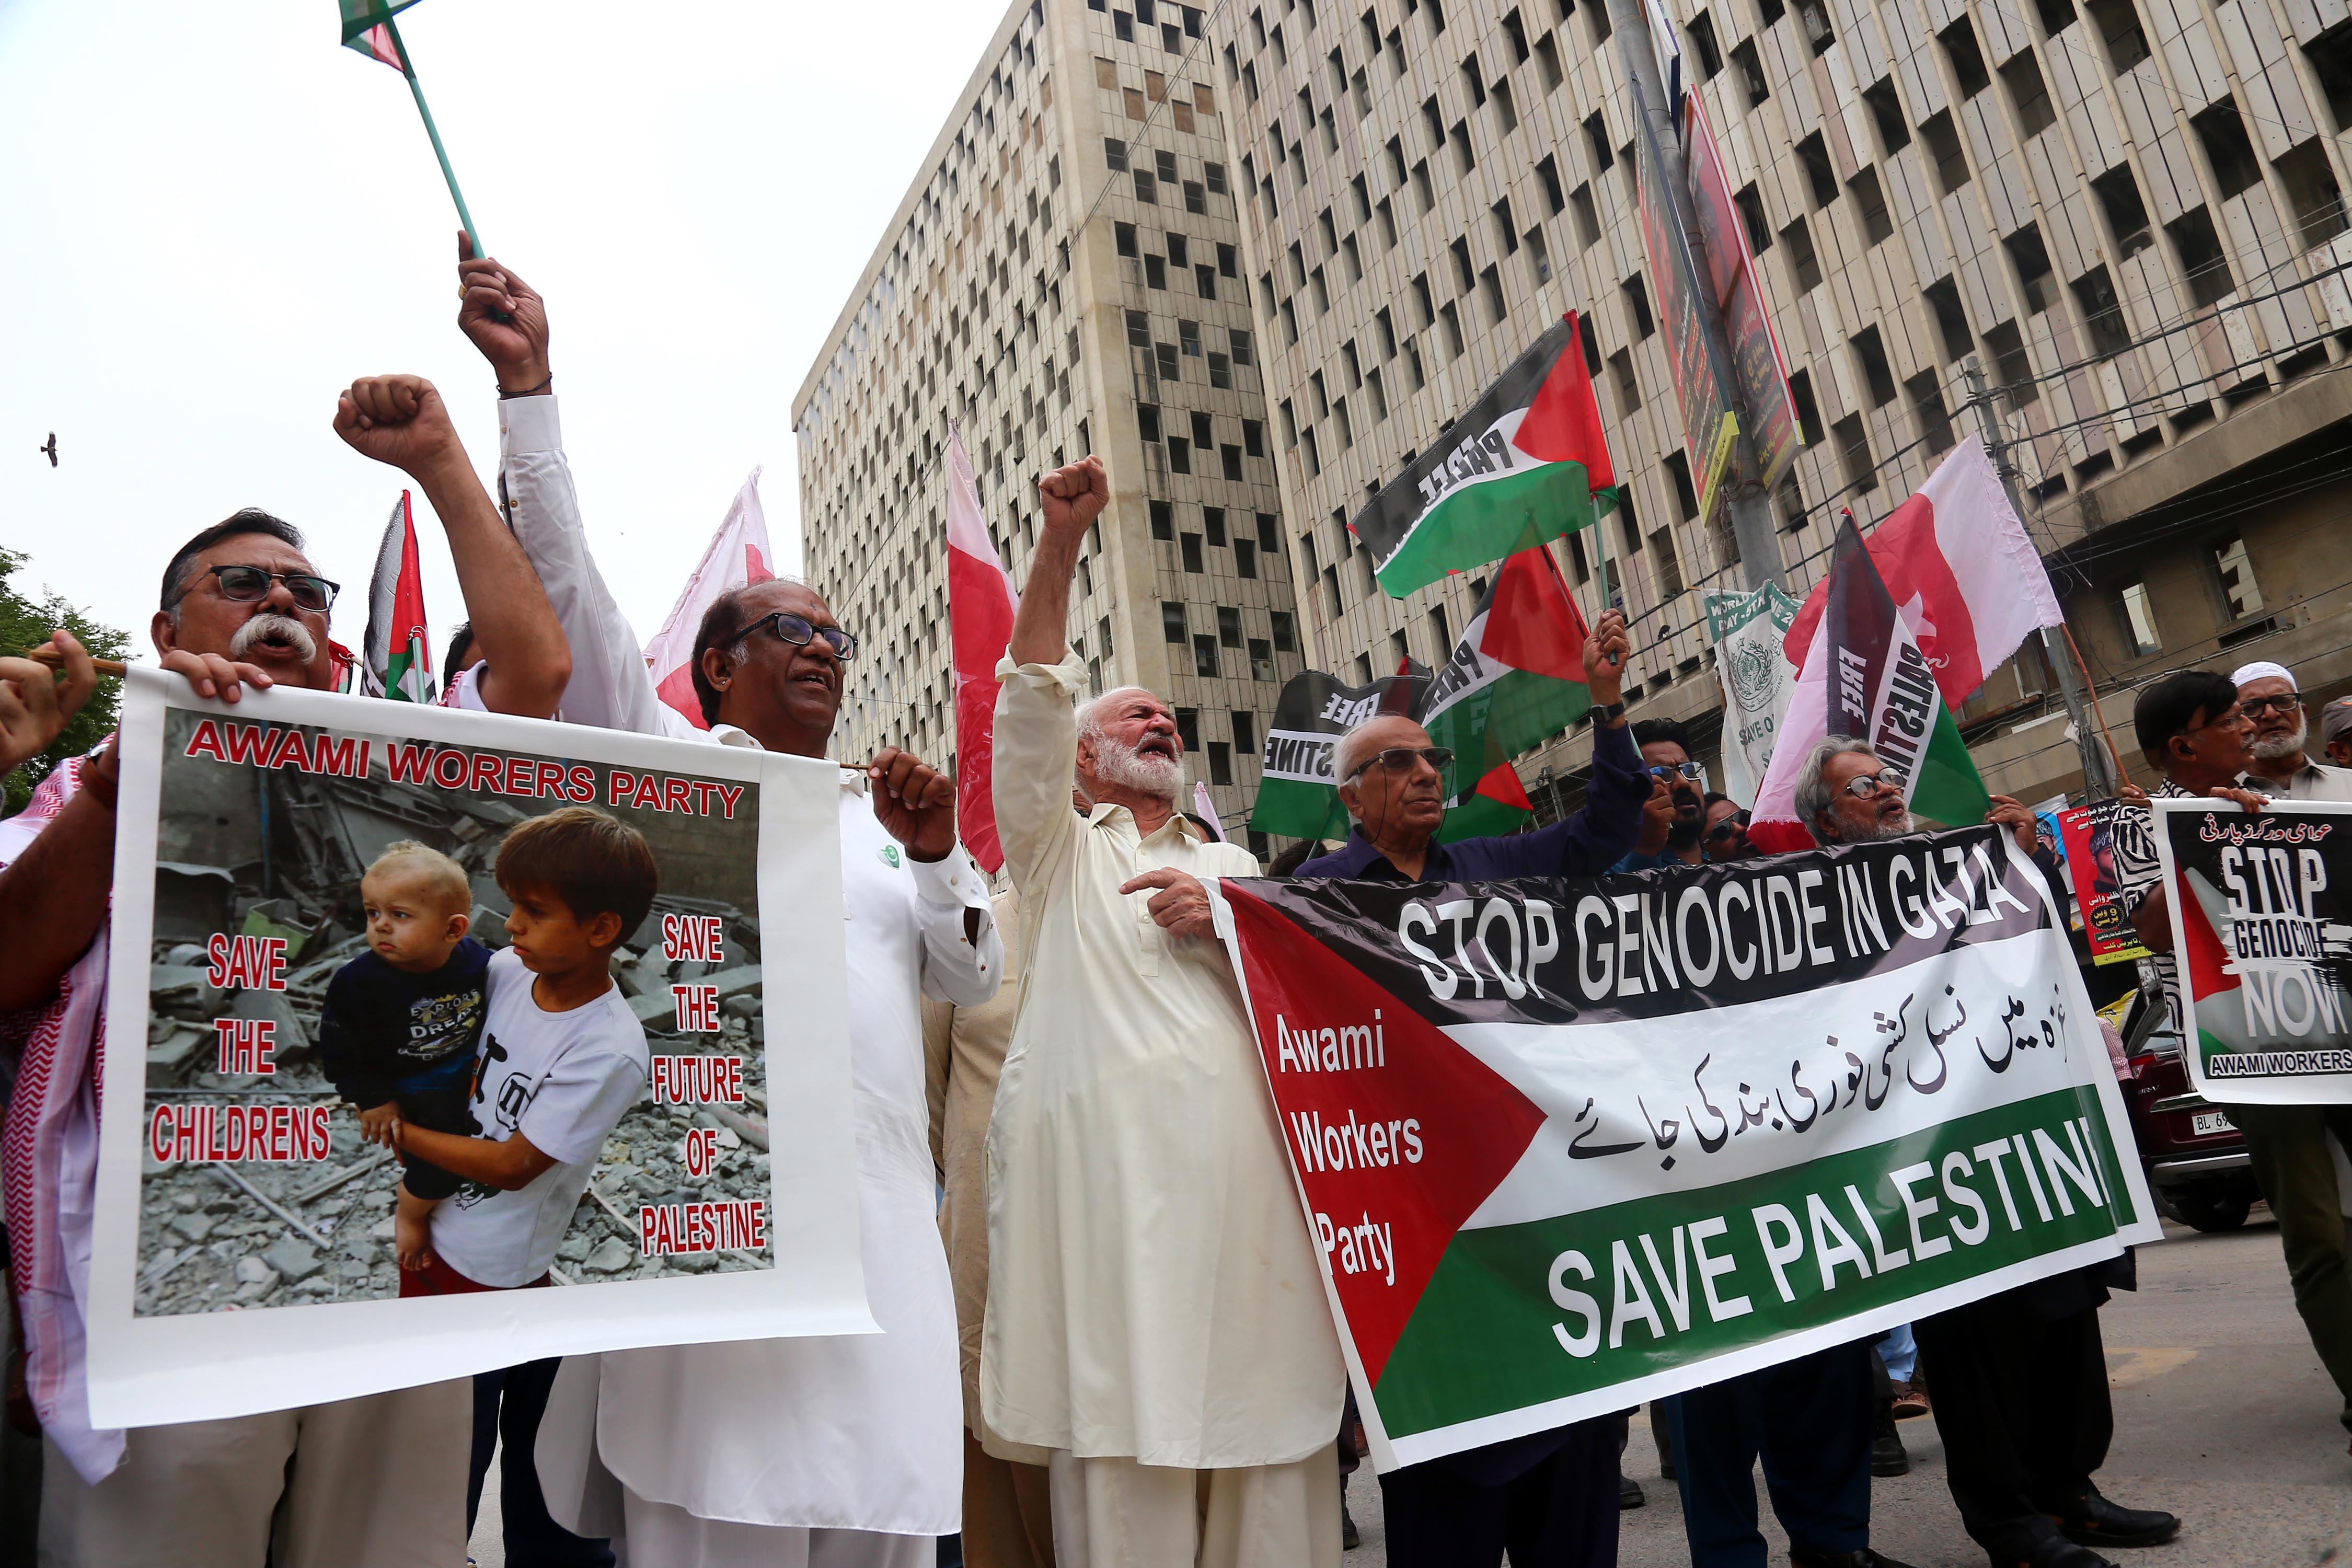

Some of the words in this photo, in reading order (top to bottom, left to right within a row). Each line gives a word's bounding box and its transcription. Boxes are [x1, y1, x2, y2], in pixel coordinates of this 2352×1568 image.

[1711, 594, 1749, 616] WORLD
[1719, 613, 1738, 631] DAY
[1739, 721, 1764, 746] SAVE
[184, 720, 371, 779] AWAMI
[387, 742, 595, 804] WORERS
[609, 769, 745, 820] PARTY
[2200, 813, 2245, 846] پارٹی
[2286, 823, 2332, 843] عوامی
[2221, 846, 2327, 919] STOP
[661, 913, 724, 963] SAVE
[1398, 897, 1559, 1000] STOP
[1575, 869, 1835, 1000] GENOCIDE
[1836, 861, 1891, 958] IN
[1889, 842, 2031, 939] GAZA
[2233, 918, 2327, 959] GENOCIDE
[206, 933, 288, 991] SAVE
[670, 983, 721, 1032] THE
[2240, 969, 2349, 1037] NOW
[214, 1018, 276, 1075] THE
[1276, 1008, 1385, 1073] Awami
[1865, 993, 1913, 1111] کشی
[1907, 983, 1966, 1094] نسل
[1976, 995, 2038, 1074] میں
[2210, 1053, 2267, 1076] AWAMI
[2266, 1049, 2352, 1075] WORKERS
[651, 1055, 745, 1104] FUTURE
[1686, 1052, 1728, 1154] کی
[1776, 1034, 1863, 1134] فوری
[150, 1103, 330, 1163] CHILDRENS
[1568, 1094, 1680, 1171] جائے
[1735, 1082, 1783, 1136] بند
[2197, 1115, 2210, 1130] BL
[685, 1127, 718, 1179] OF
[1290, 1109, 1424, 1173] Workers
[639, 1200, 767, 1258] PALESTINE
[1315, 1209, 1396, 1286] Party
[1548, 1216, 1754, 1358] SAVE
